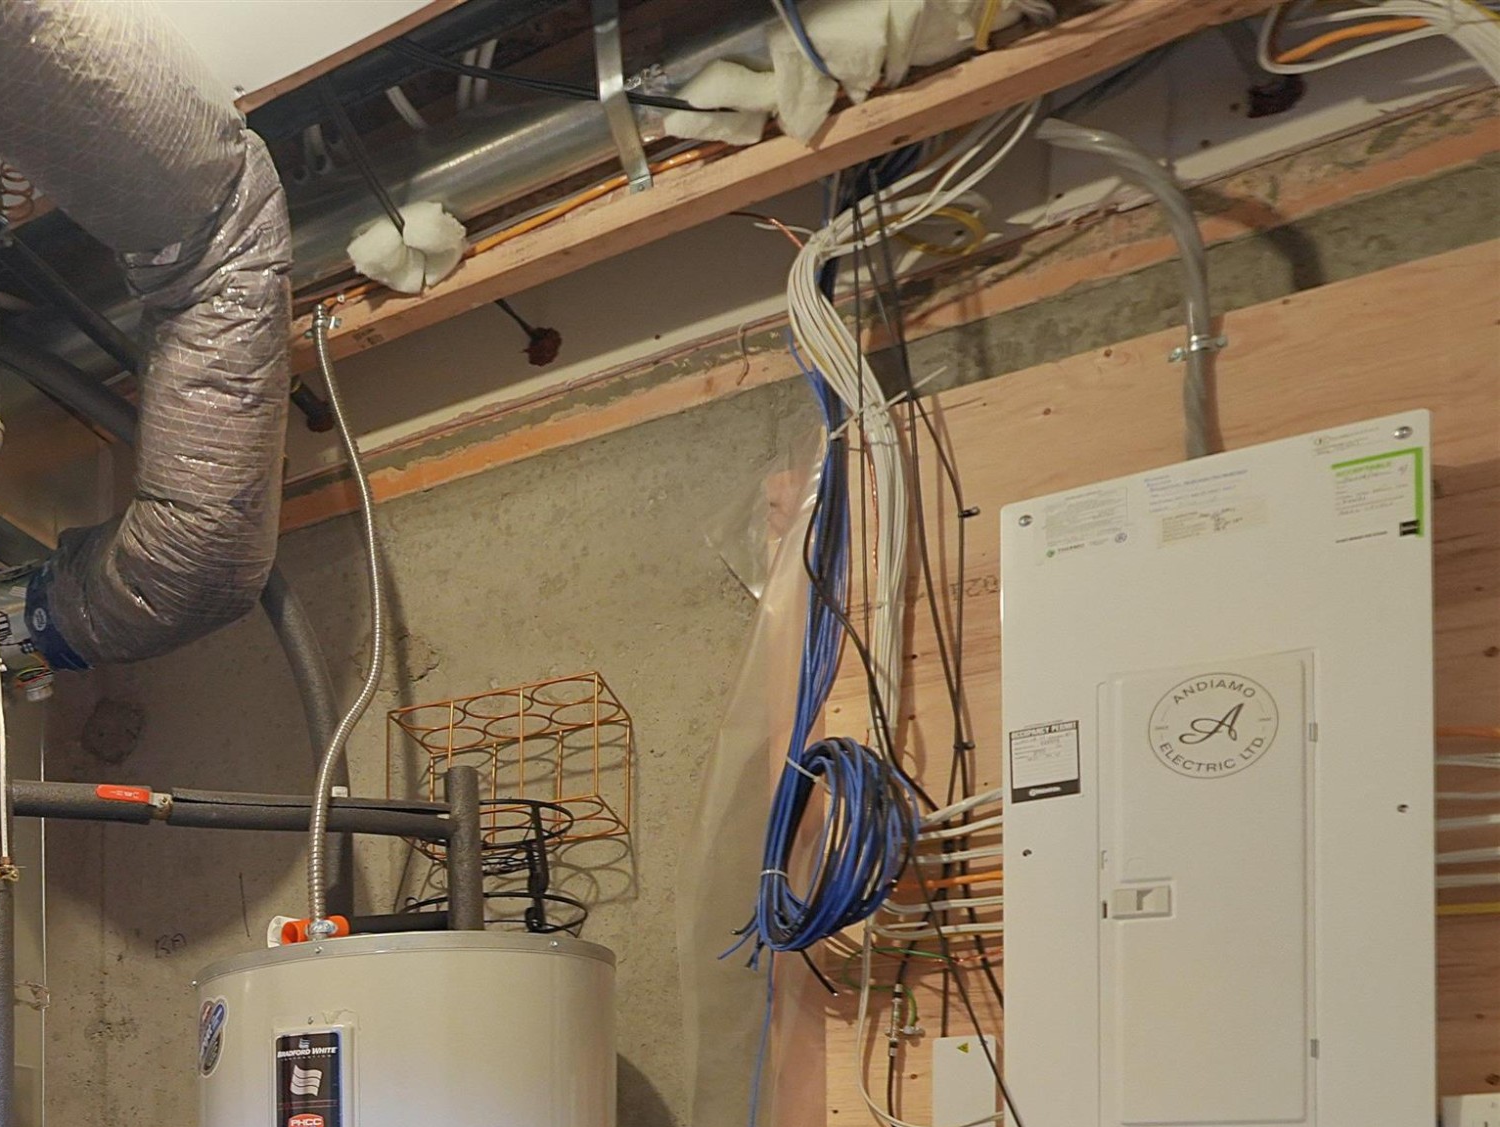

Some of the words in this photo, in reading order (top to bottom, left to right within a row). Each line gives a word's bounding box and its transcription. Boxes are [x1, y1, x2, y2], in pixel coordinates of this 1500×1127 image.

[1173, 679, 1256, 704] ANDIAMO
[1160, 742, 1237, 772] ELECTRIC
[277, 1048, 311, 1058] BRADFORD
[312, 1046, 338, 1055] WHITE
[290, 1118, 323, 1127] PHCC
